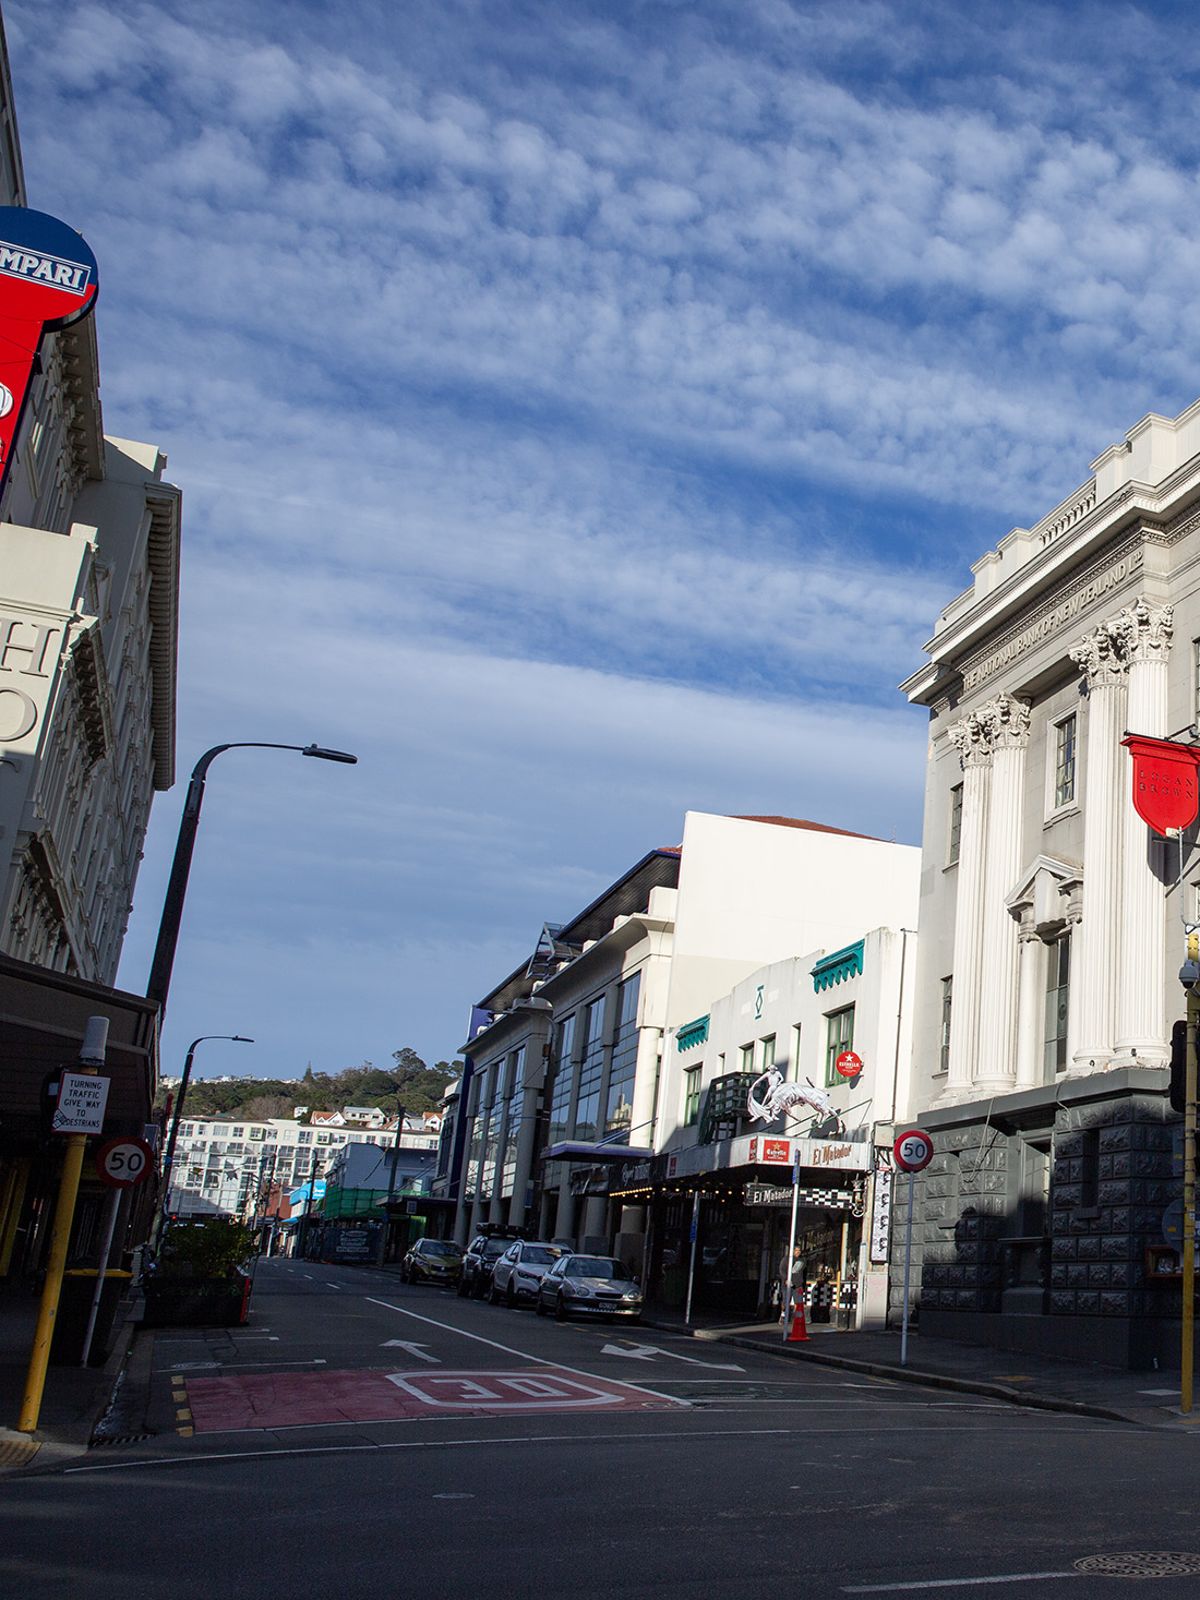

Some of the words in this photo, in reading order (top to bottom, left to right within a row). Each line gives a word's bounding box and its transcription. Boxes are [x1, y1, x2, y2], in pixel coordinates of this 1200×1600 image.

[963, 673, 977, 691] THE
[977, 646, 1017, 682] NATIONAL
[1017, 629, 1042, 656] BANK
[1042, 619, 1055, 636] OF
[1055, 602, 1080, 625] NEW
[1080, 563, 1126, 608] ZEALAND
[1140, 770, 1193, 786] LOGAN
[1140, 782, 1193, 799] BROWN
[70, 1080, 102, 1090] TURNING
[69, 1089, 100, 1099] TRAFFIC
[63, 1099, 82, 1107] GIVE
[85, 1100, 101, 1109] WAY
[62, 1119, 100, 1128] DESTRIANS
[812, 1148, 821, 1165] El
[822, 1144, 852, 1165] Matador
[904, 1143, 926, 1158] 50
[109, 1152, 142, 1171] 50
[753, 1191, 762, 1203] El
[763, 1189, 793, 1203] Matador
[431, 1378, 571, 1400] 30
